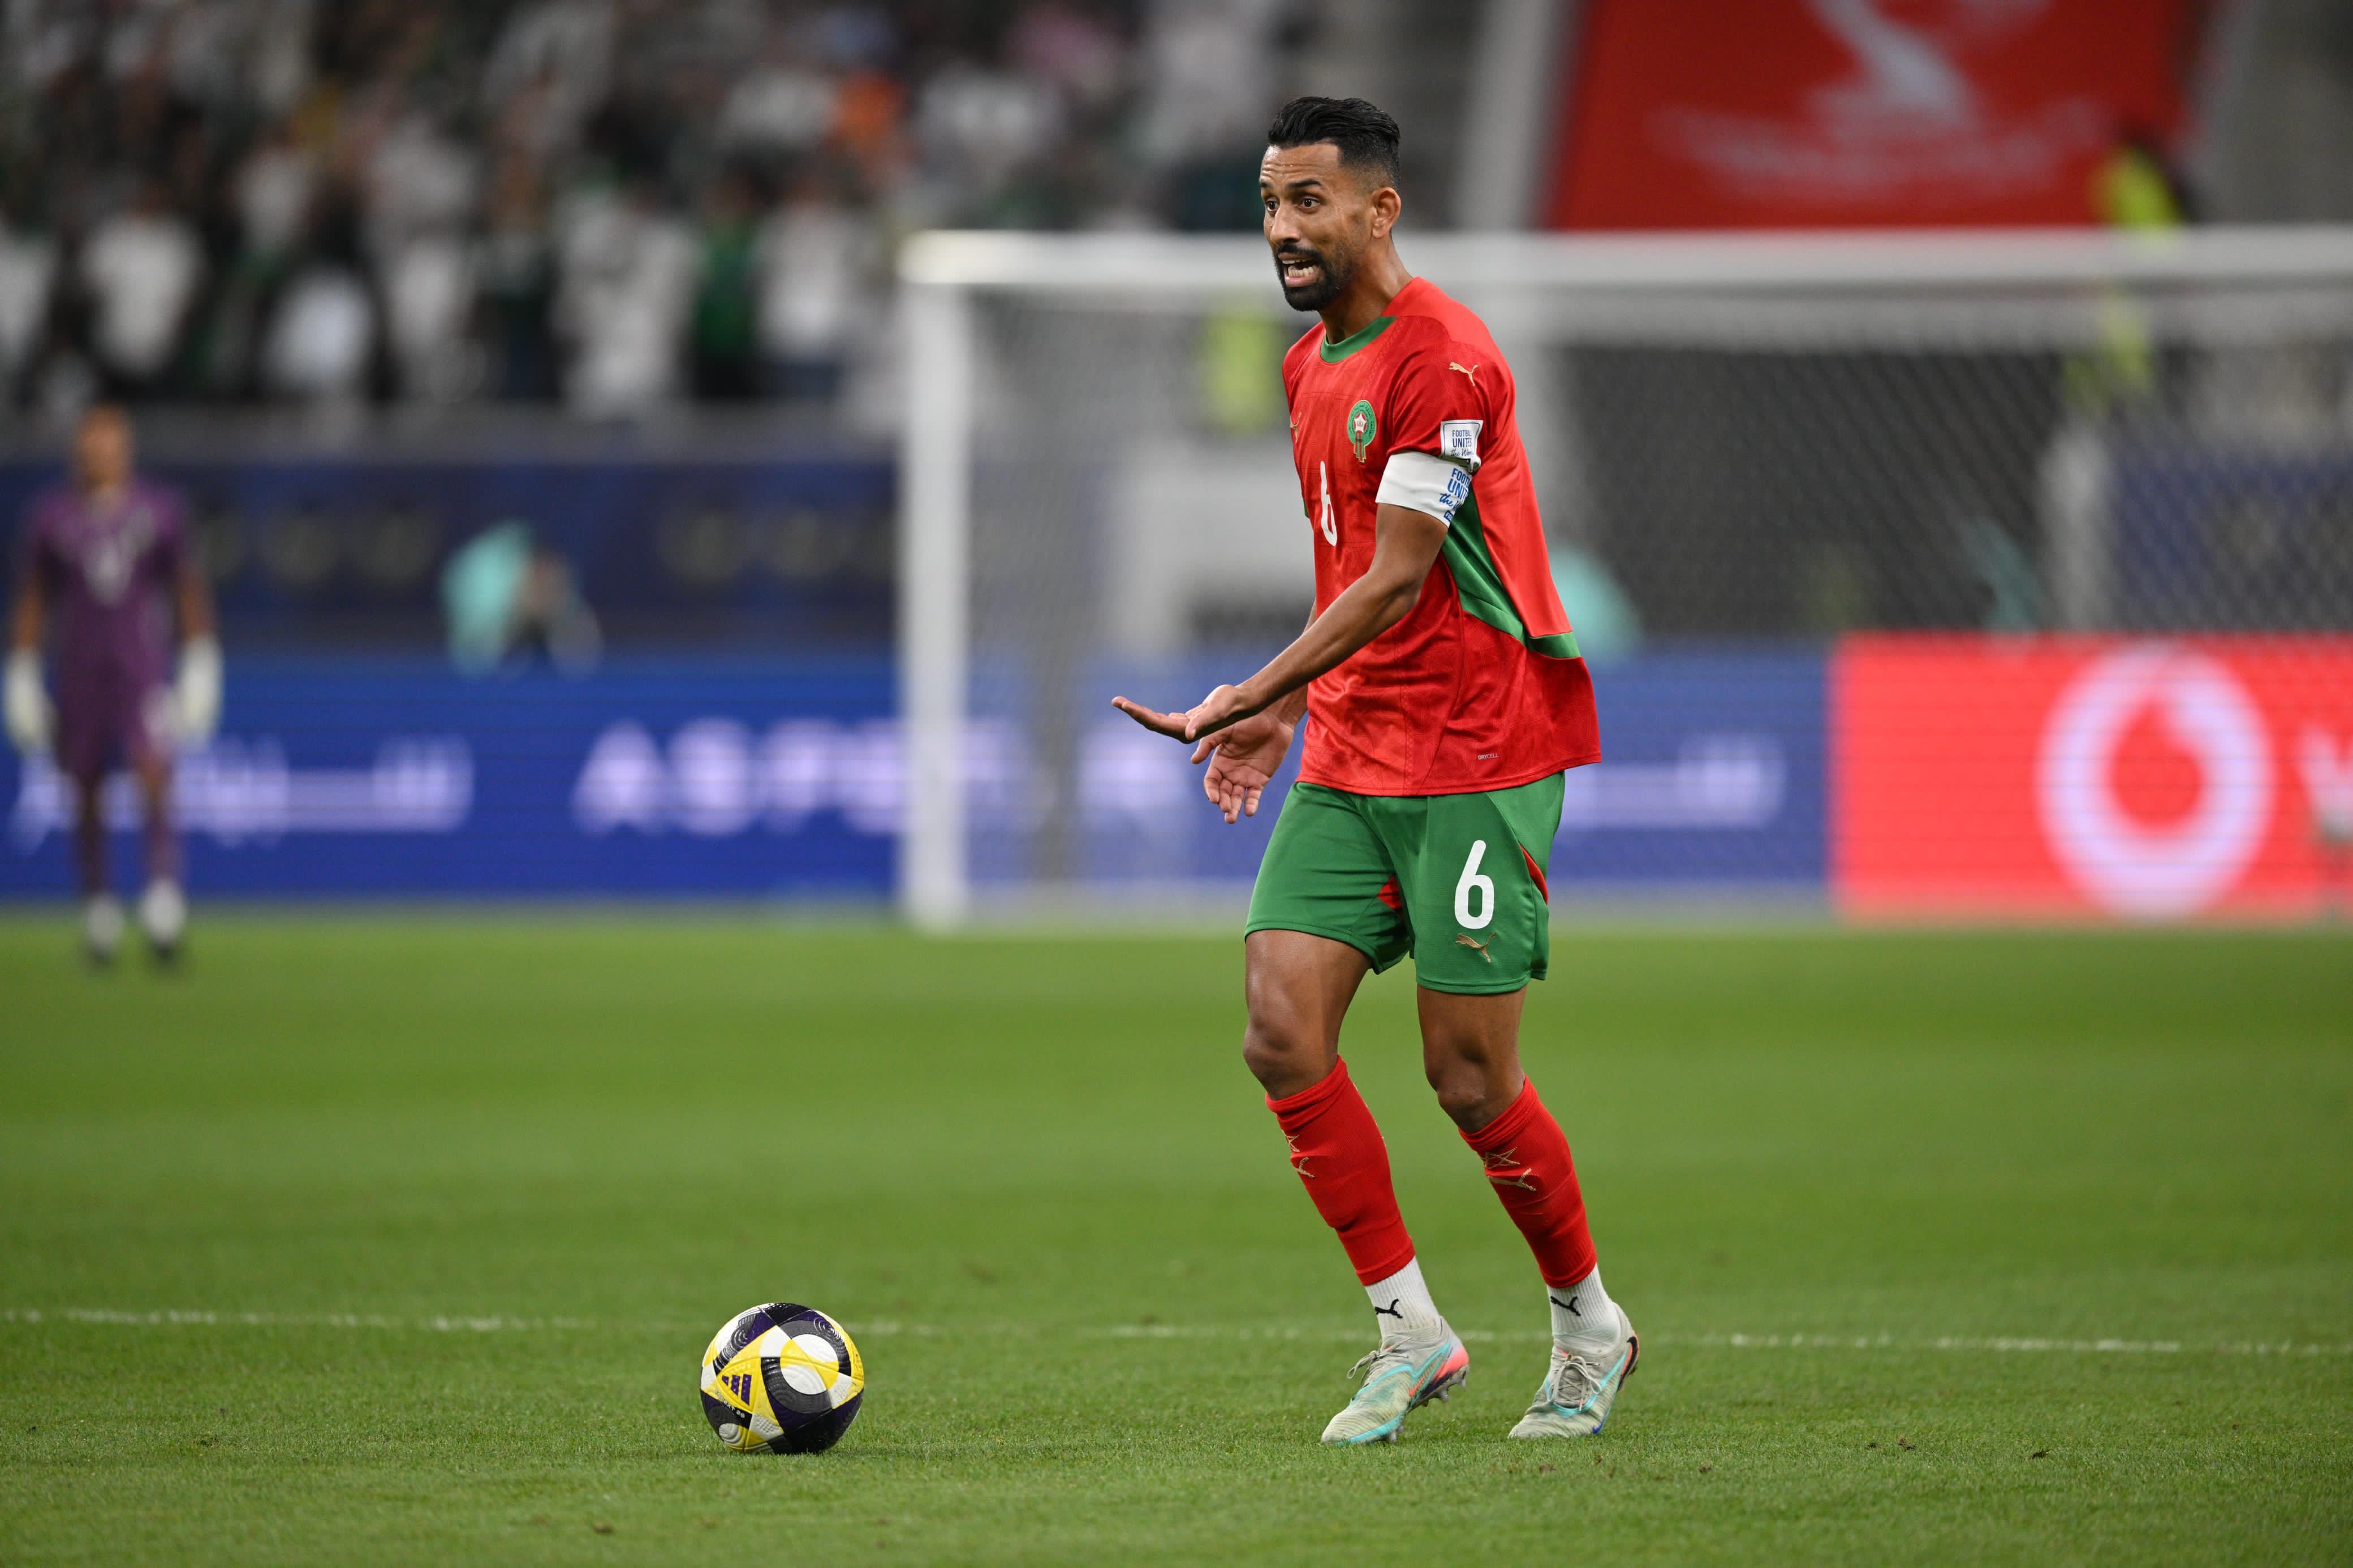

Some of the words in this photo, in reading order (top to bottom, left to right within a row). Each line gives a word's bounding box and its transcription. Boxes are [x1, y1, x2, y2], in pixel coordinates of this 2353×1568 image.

[1451, 468, 1471, 487] FOOT
[1439, 493, 1454, 507] the
[1447, 478, 1469, 502] UNIT
[1320, 461, 1338, 547] 6
[1454, 840, 1494, 930] 6
